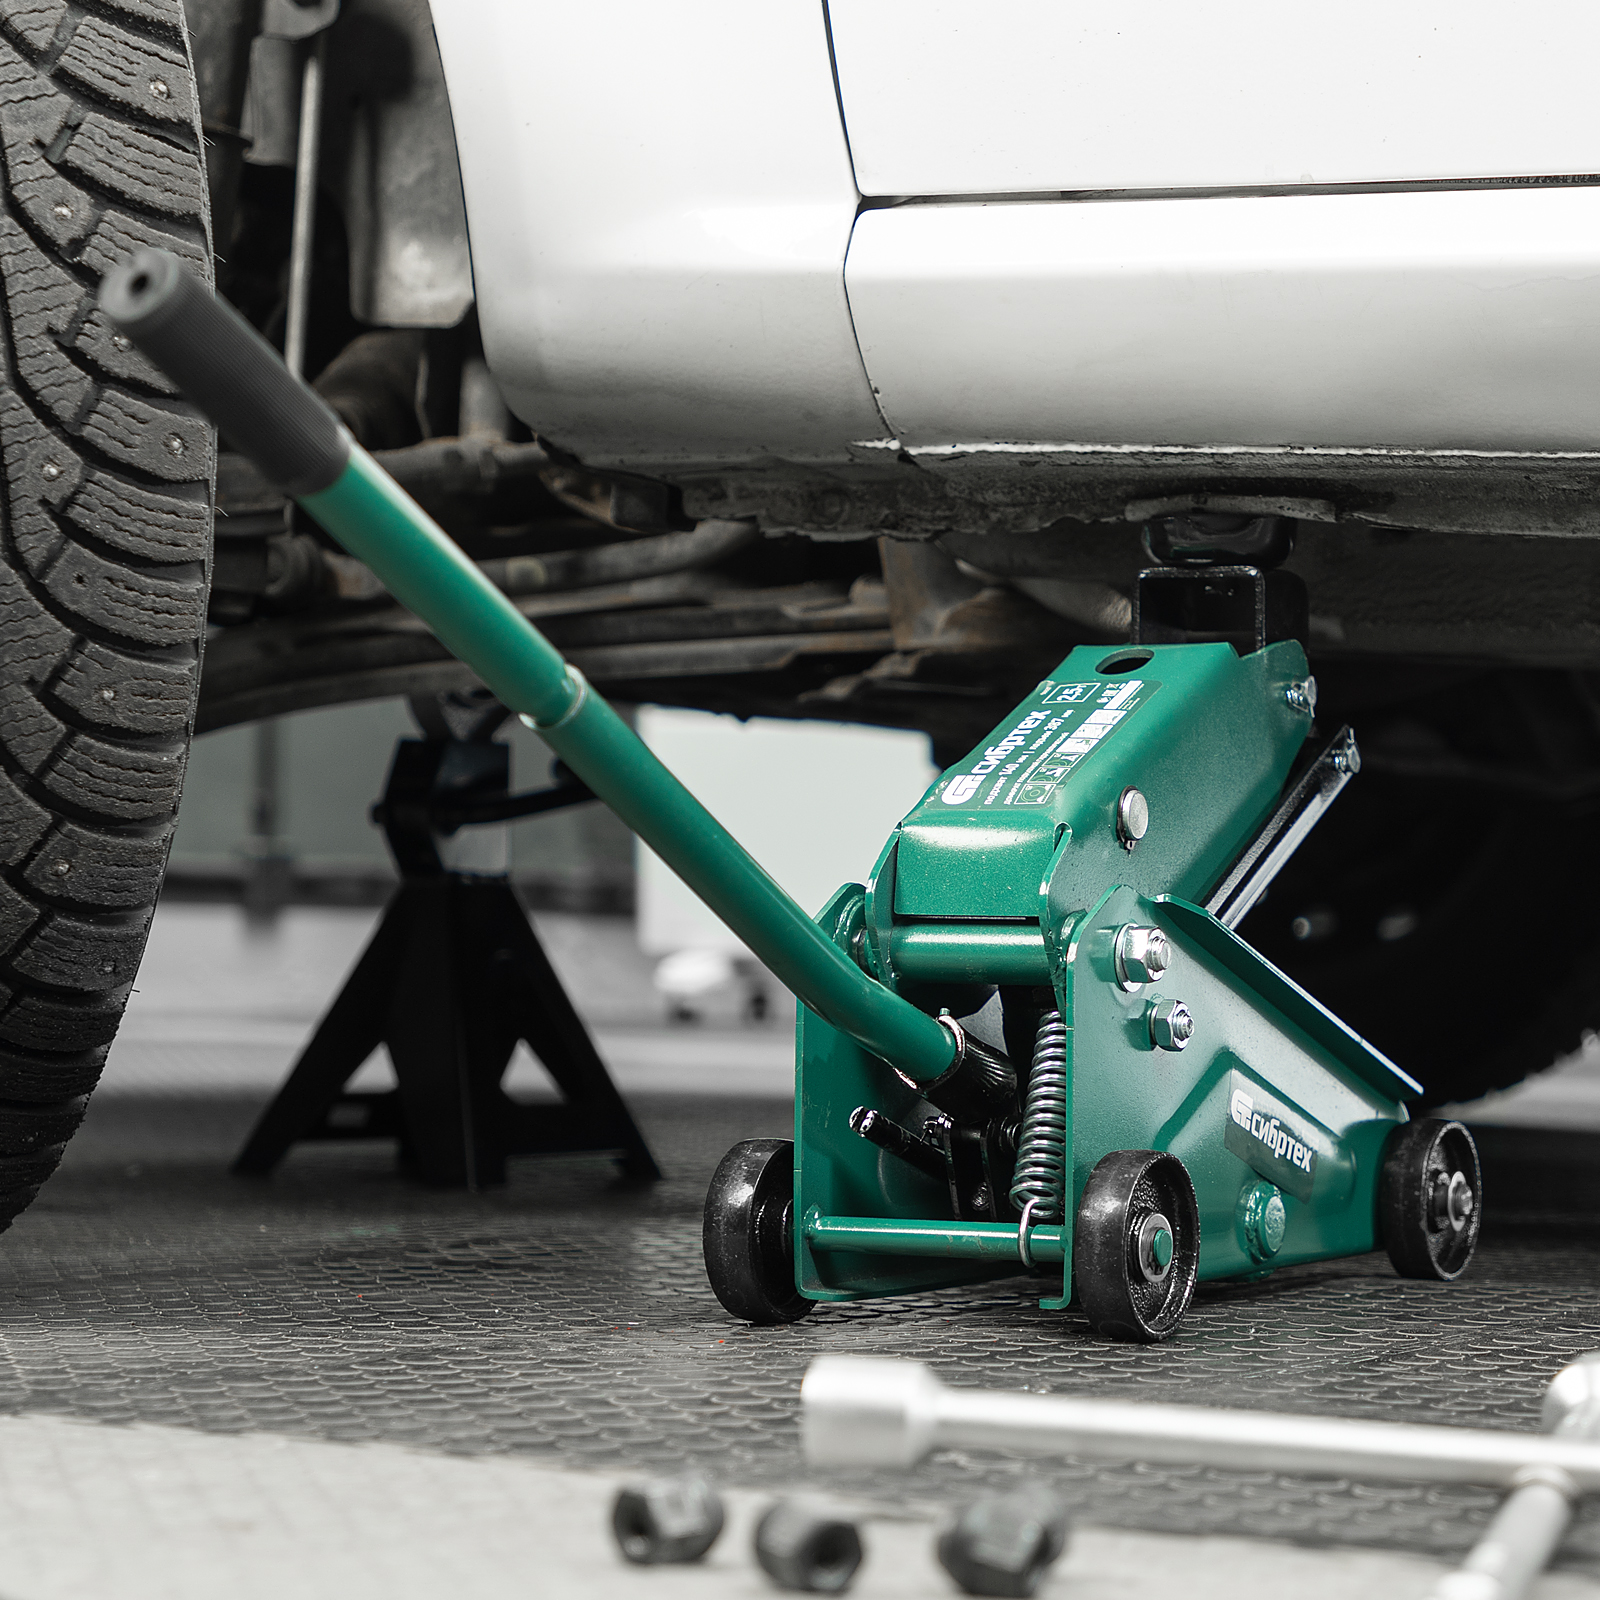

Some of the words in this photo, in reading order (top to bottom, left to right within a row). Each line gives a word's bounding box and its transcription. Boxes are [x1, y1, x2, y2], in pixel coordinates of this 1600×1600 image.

[970, 710, 1052, 775] сибртех
[998, 763, 1020, 776] 140
[1250, 1112, 1313, 1174] сибртех
